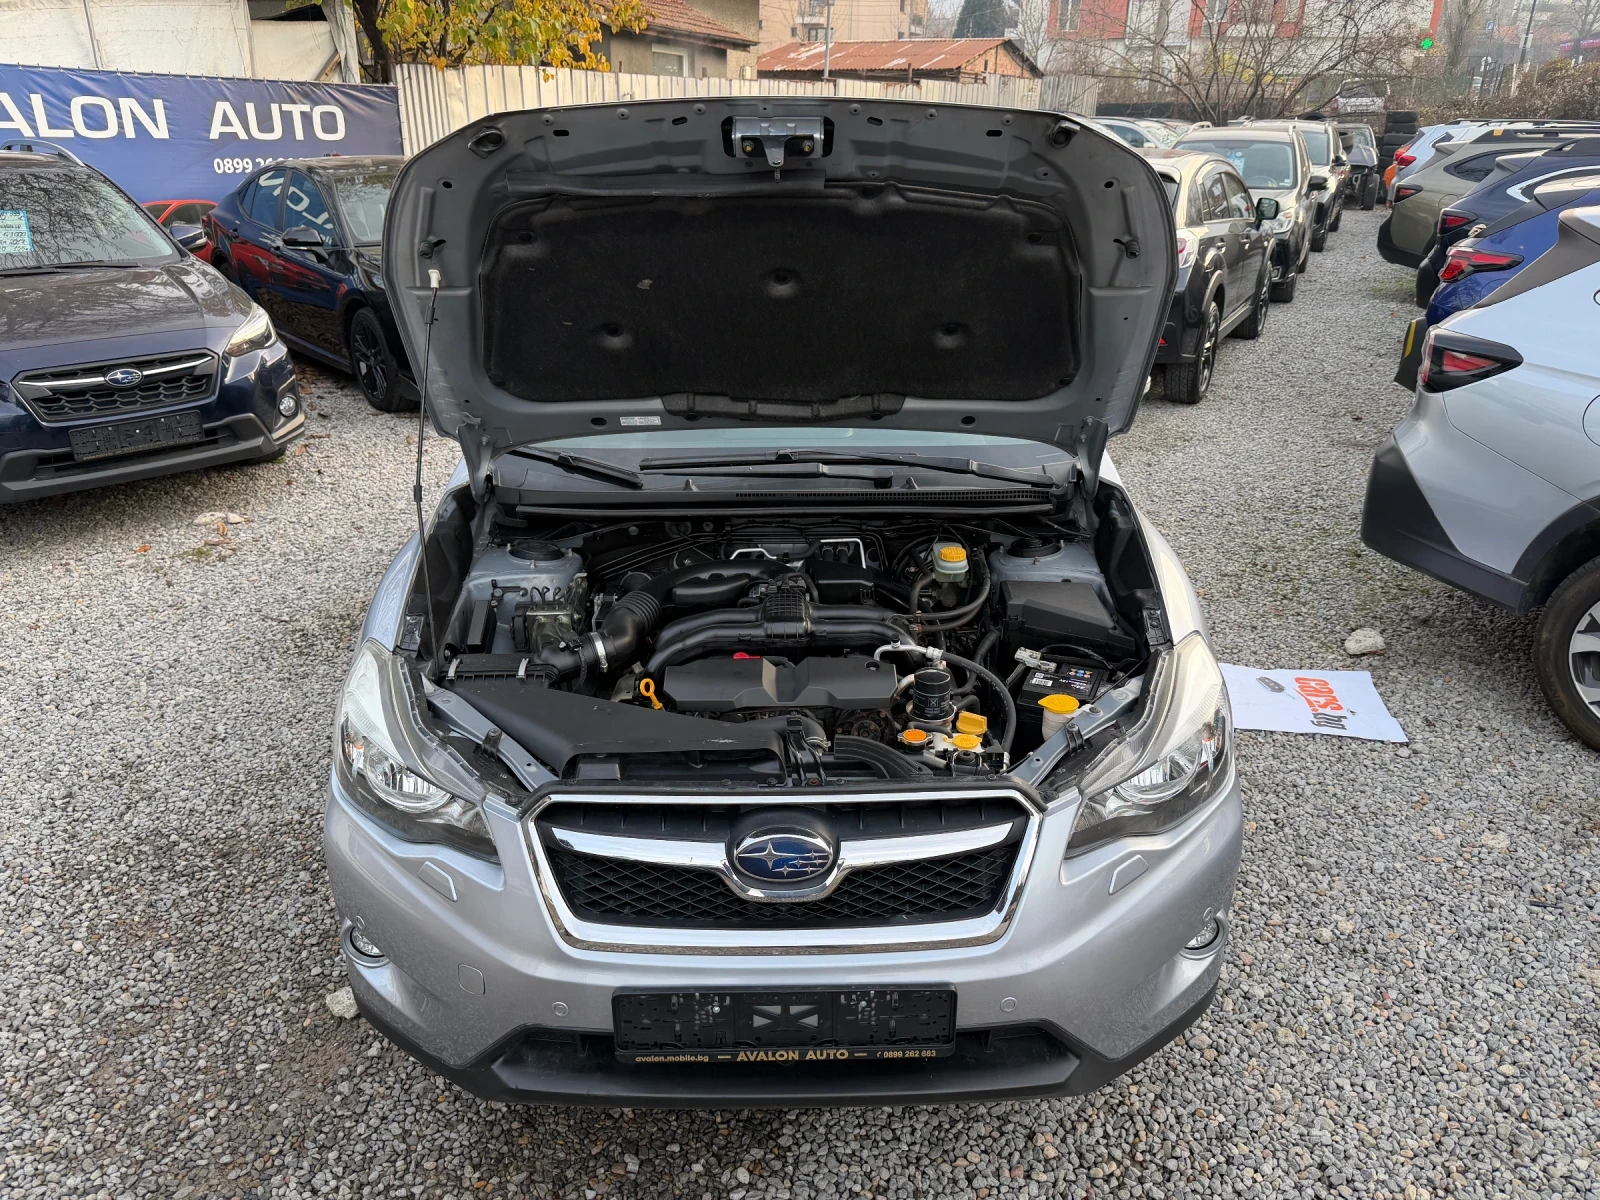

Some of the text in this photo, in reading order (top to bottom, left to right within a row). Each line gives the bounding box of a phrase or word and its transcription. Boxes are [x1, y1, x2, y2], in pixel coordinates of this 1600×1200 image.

[209, 101, 346, 141] AUTO
[213, 157, 253, 174] 0899
[635, 1054, 709, 1063] avalon.mobile.bg
[736, 1050, 799, 1062] AVALON
[805, 1048, 849, 1060] AUTO
[883, 1050, 903, 1058] 0899
